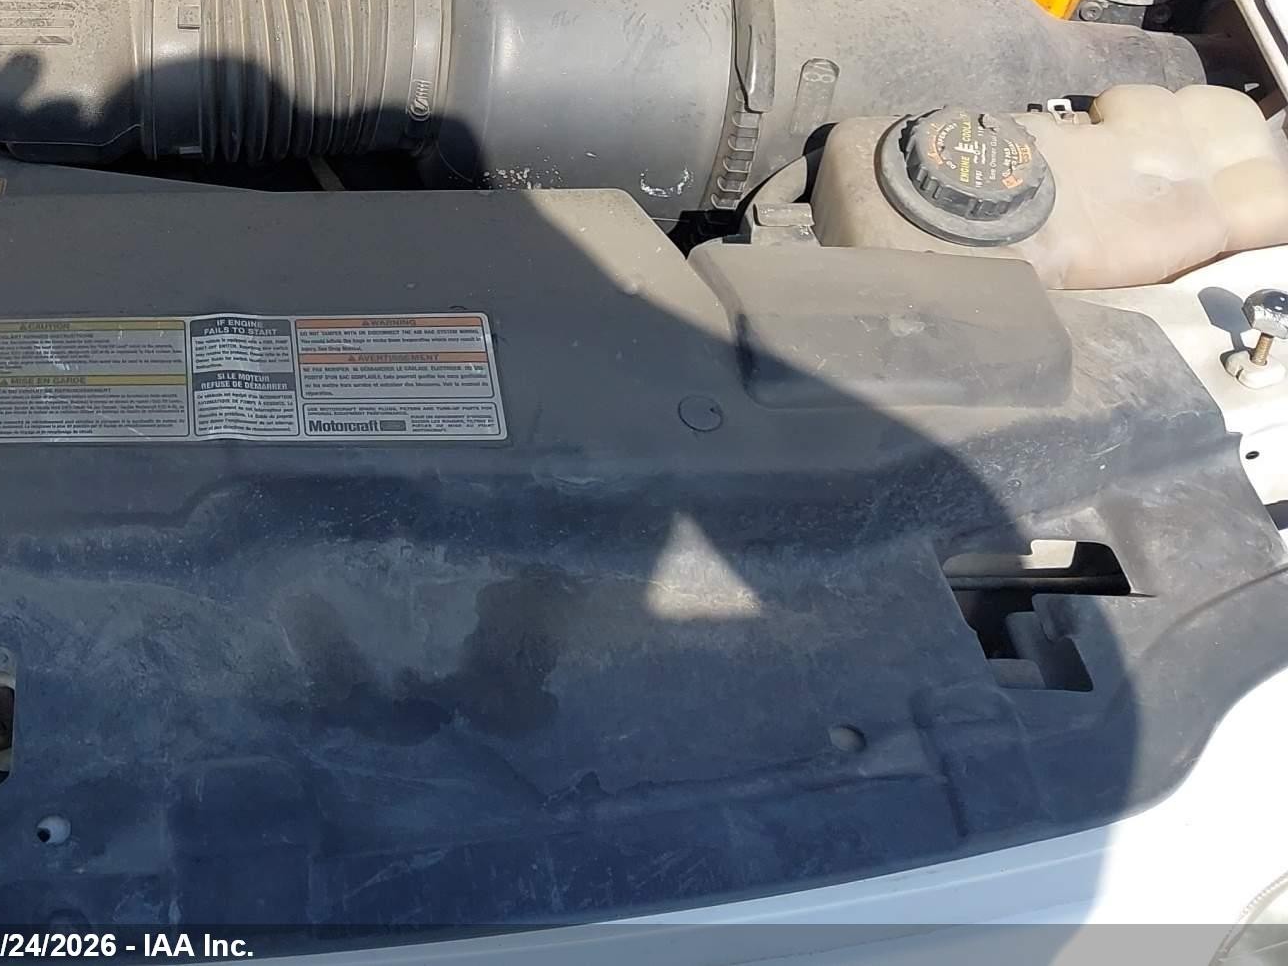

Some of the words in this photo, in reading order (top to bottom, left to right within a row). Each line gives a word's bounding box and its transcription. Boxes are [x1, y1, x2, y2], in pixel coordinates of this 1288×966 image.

[989, 148, 997, 168] Owner
[960, 155, 970, 183] ENGINE
[28, 322, 70, 330] CAUTION
[228, 319, 263, 327] ENGINE
[204, 326, 230, 335] FAILS
[238, 374, 270, 382] MOTEUR
[201, 380, 230, 389] REFUSE
[309, 420, 379, 432] Motorcraft
